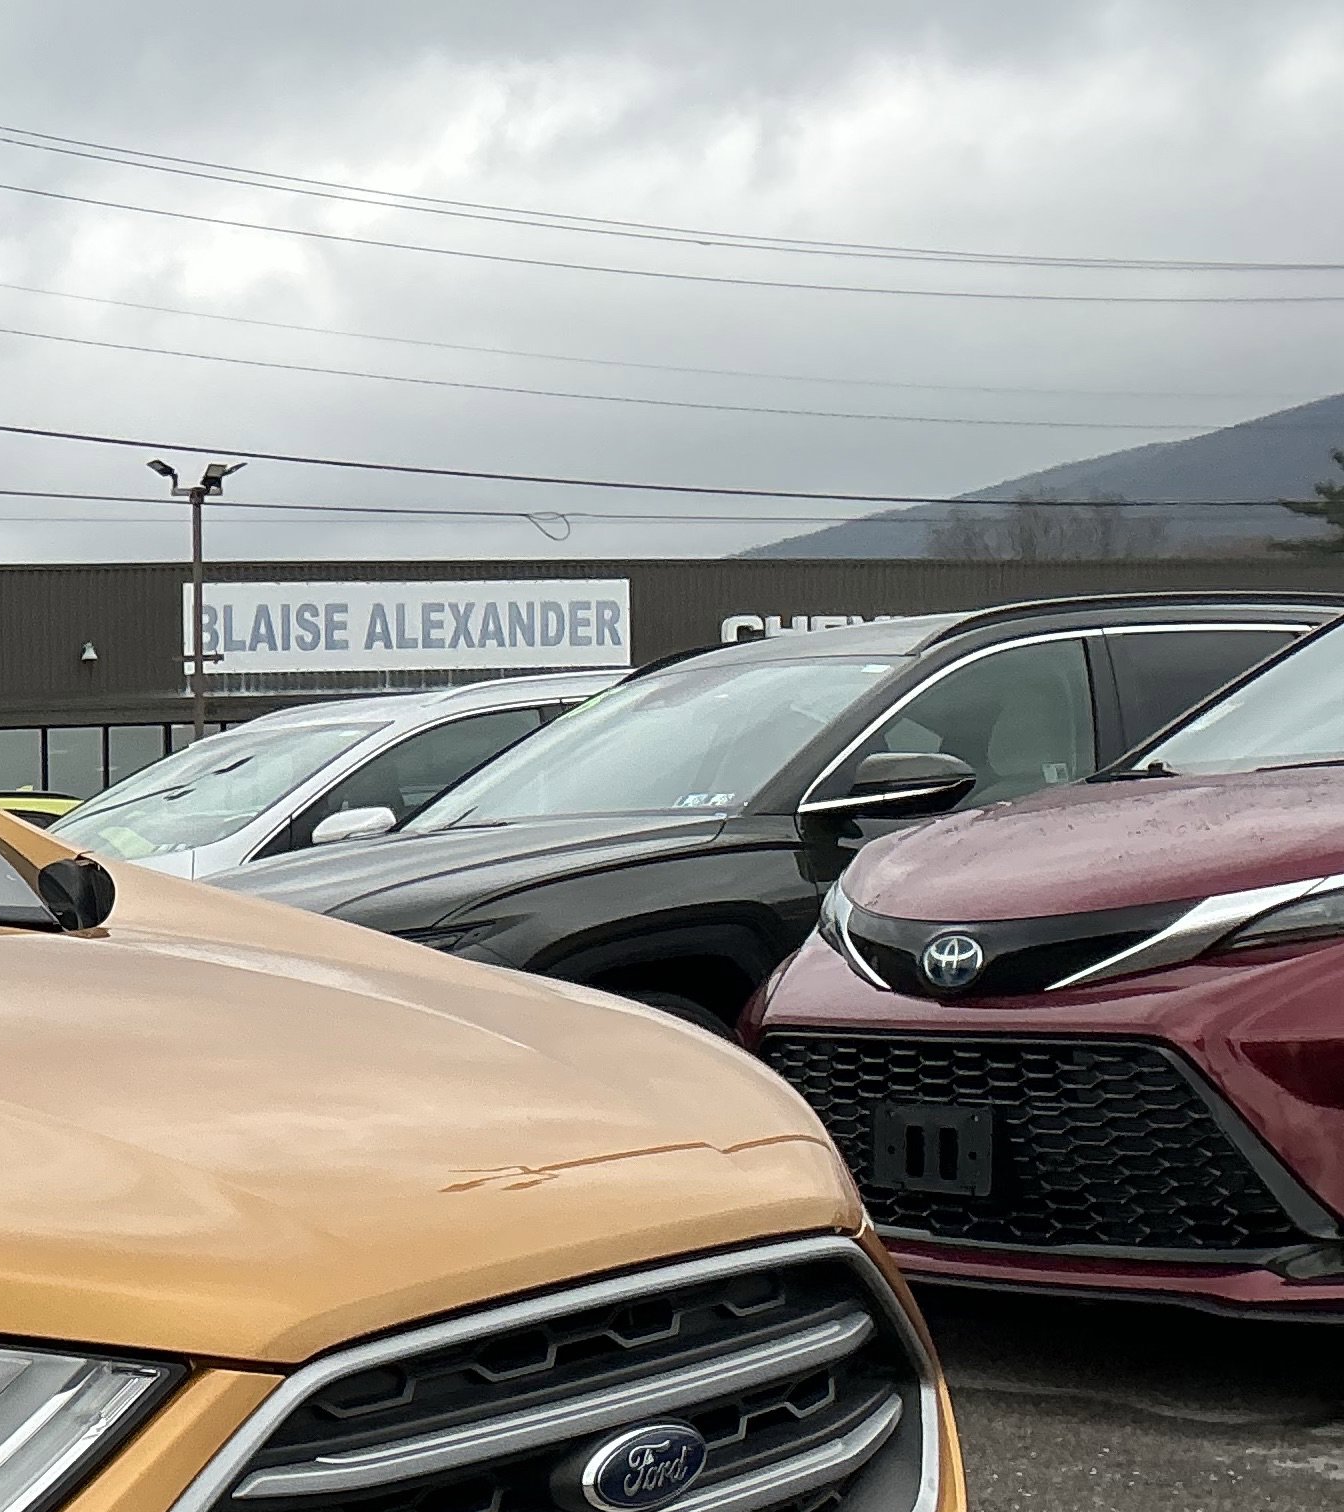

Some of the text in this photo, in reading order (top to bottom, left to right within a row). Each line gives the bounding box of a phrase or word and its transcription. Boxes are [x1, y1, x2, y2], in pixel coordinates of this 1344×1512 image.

[201, 600, 621, 652] BLAISE ALEXANDER
[623, 1439, 690, 1497] Ford
